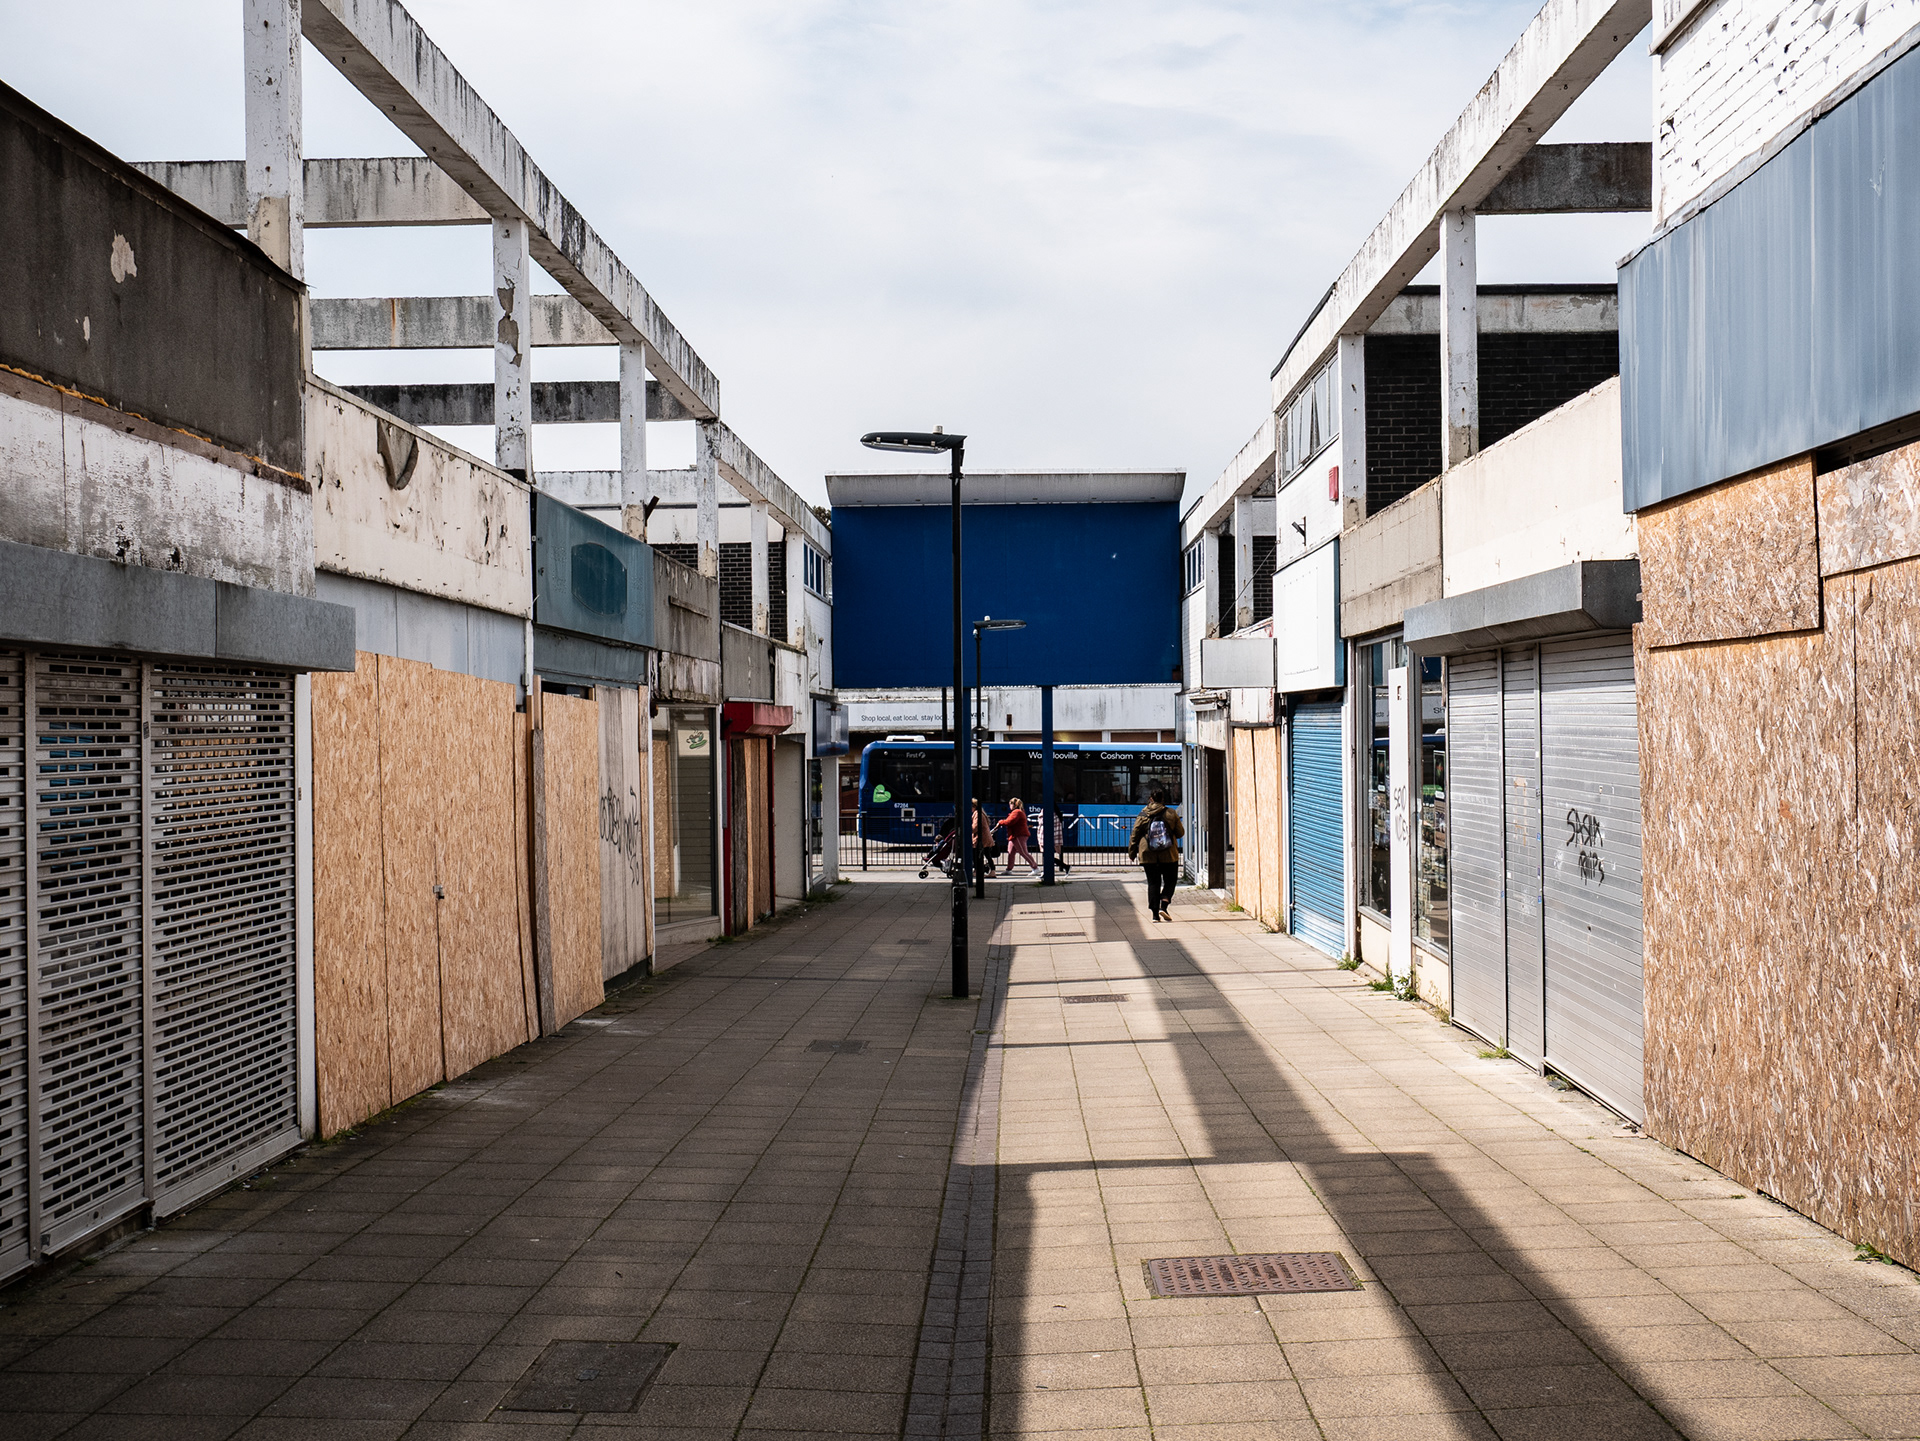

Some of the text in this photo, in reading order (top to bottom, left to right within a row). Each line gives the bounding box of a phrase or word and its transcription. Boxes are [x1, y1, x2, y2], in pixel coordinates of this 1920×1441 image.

[1028, 751, 1078, 760] Walooville
[1100, 751, 1133, 760] Cosham
[1028, 805, 1041, 813] the
